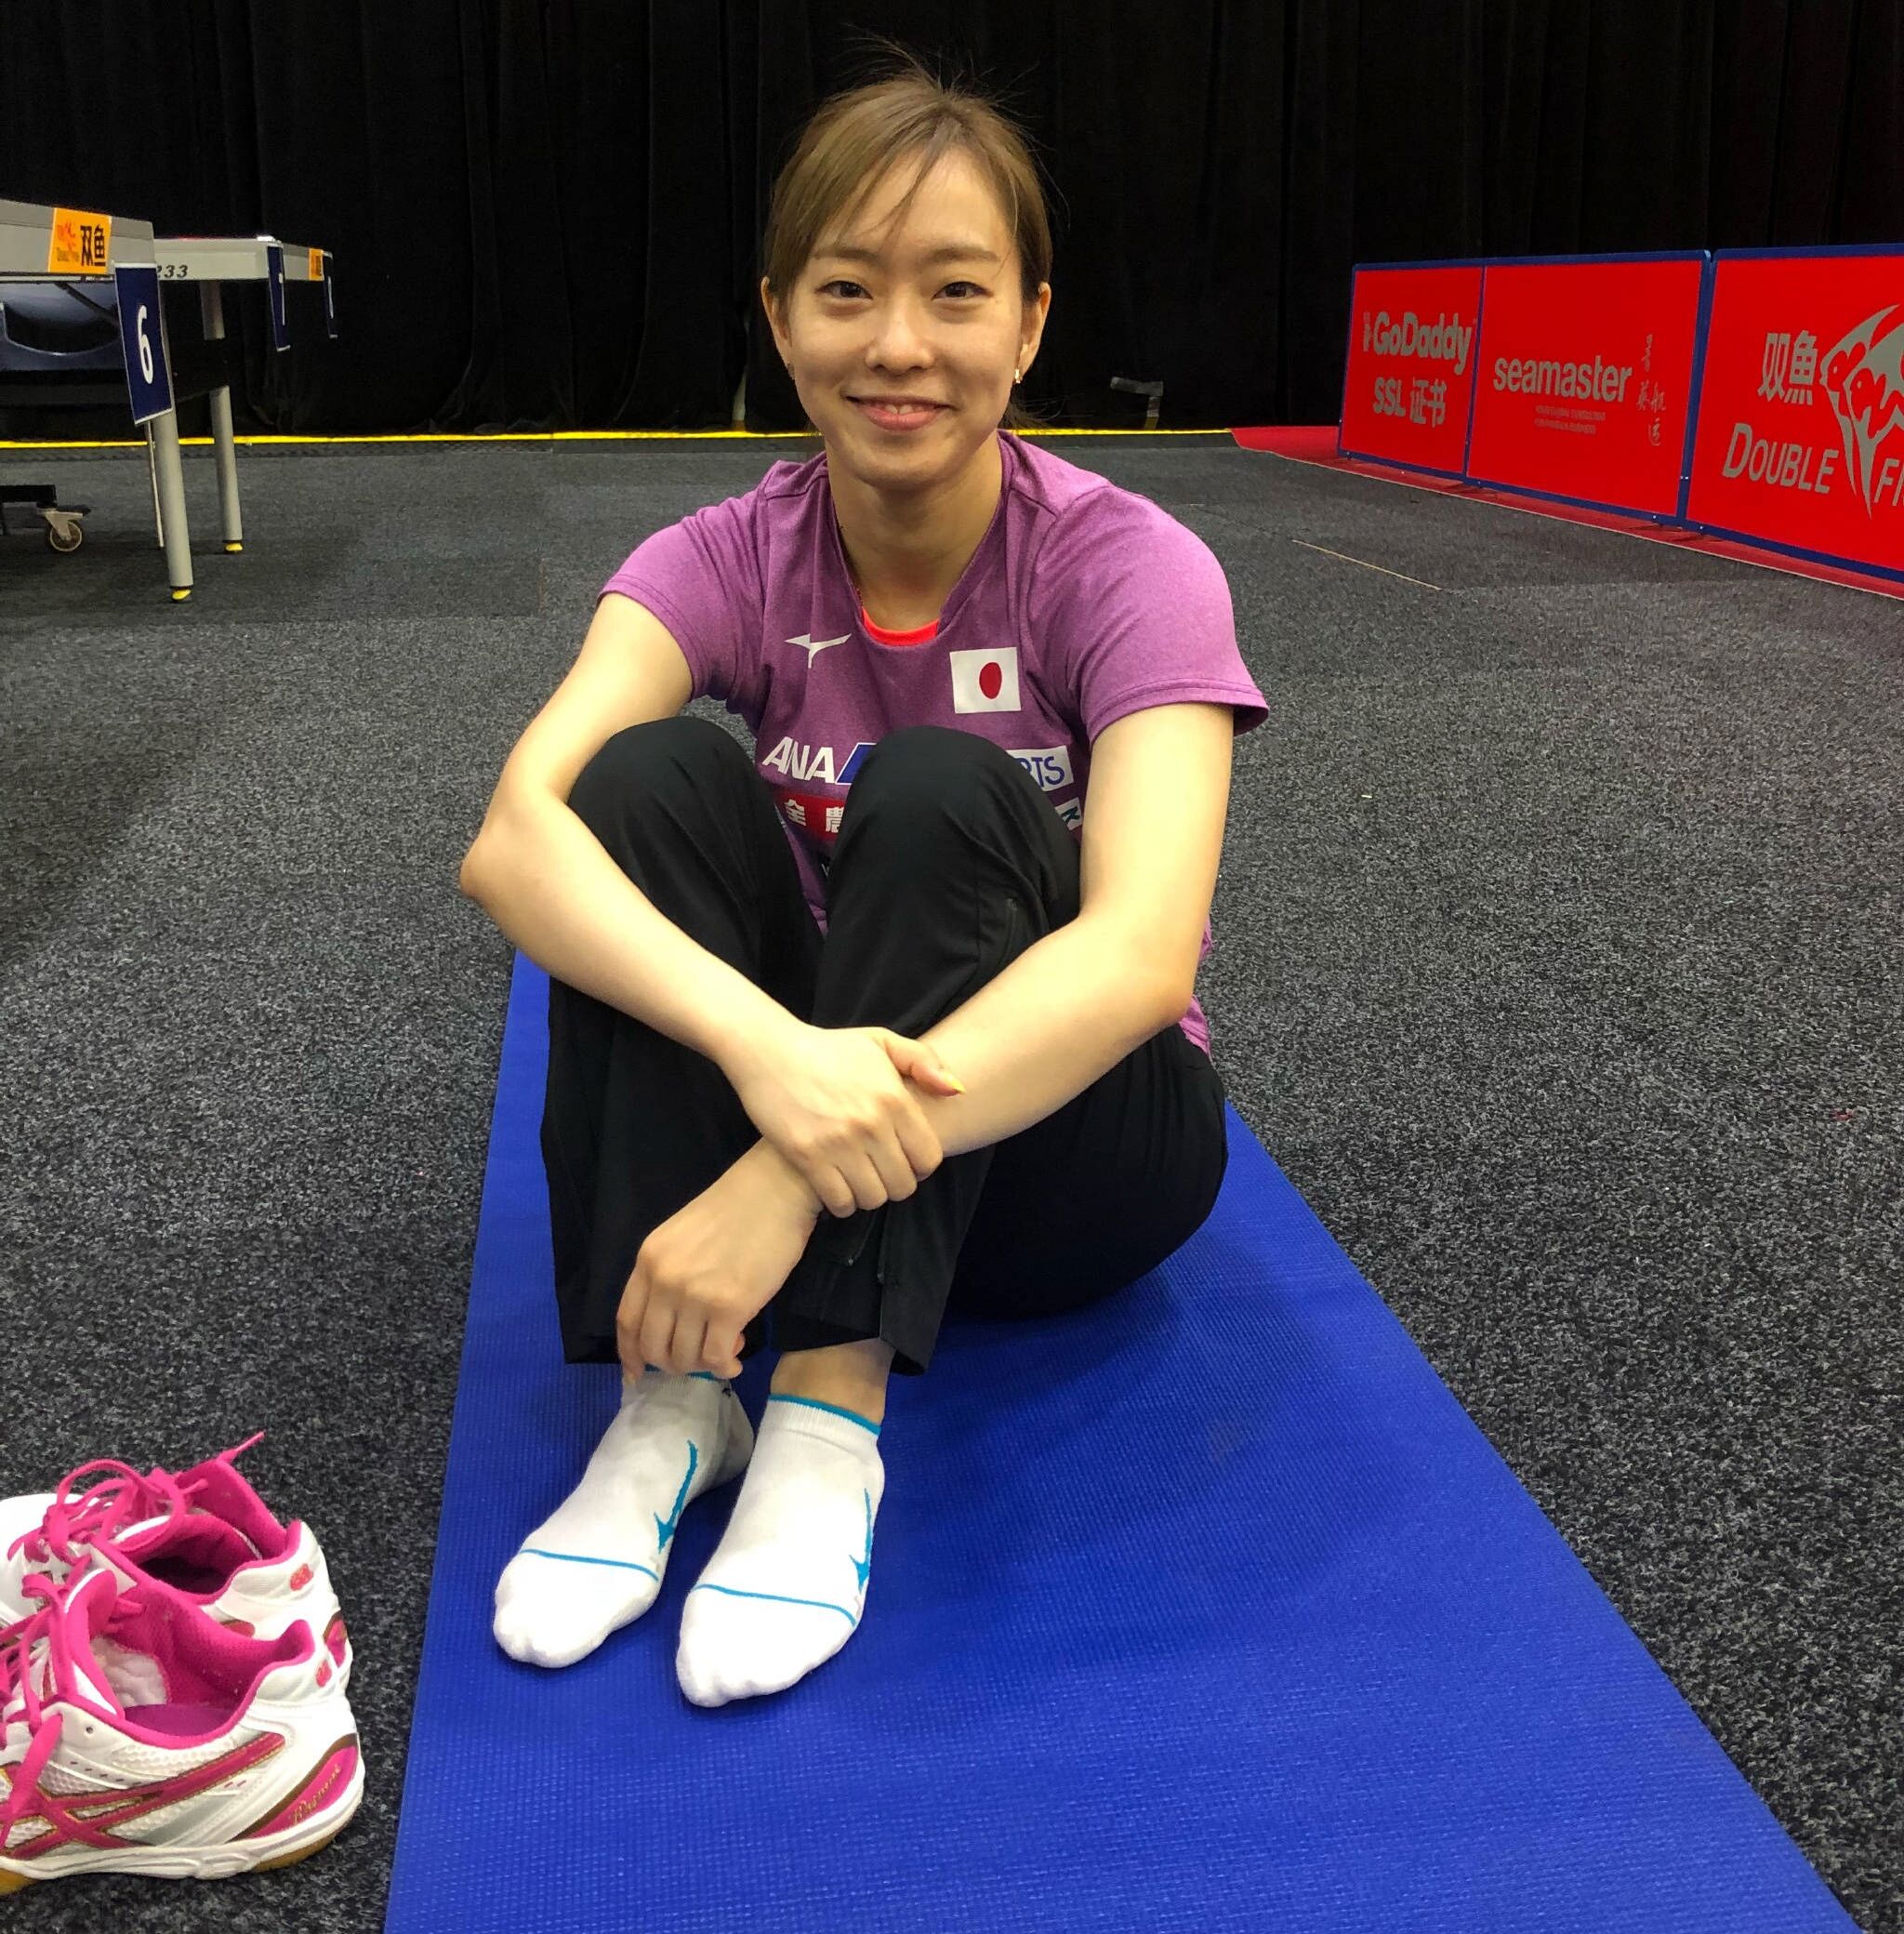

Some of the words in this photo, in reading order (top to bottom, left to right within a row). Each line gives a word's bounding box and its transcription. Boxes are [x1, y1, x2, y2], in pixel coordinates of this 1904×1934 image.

[80, 223, 107, 267] 双鱼
[138, 305, 153, 385] 6
[1373, 311, 1473, 376] GoDaddy
[1373, 377, 1406, 417] SSL
[1409, 376, 1448, 428] 证书
[1493, 354, 1633, 403] seamaster
[1873, 457, 1904, 507] FI
[762, 735, 836, 784] ANA
